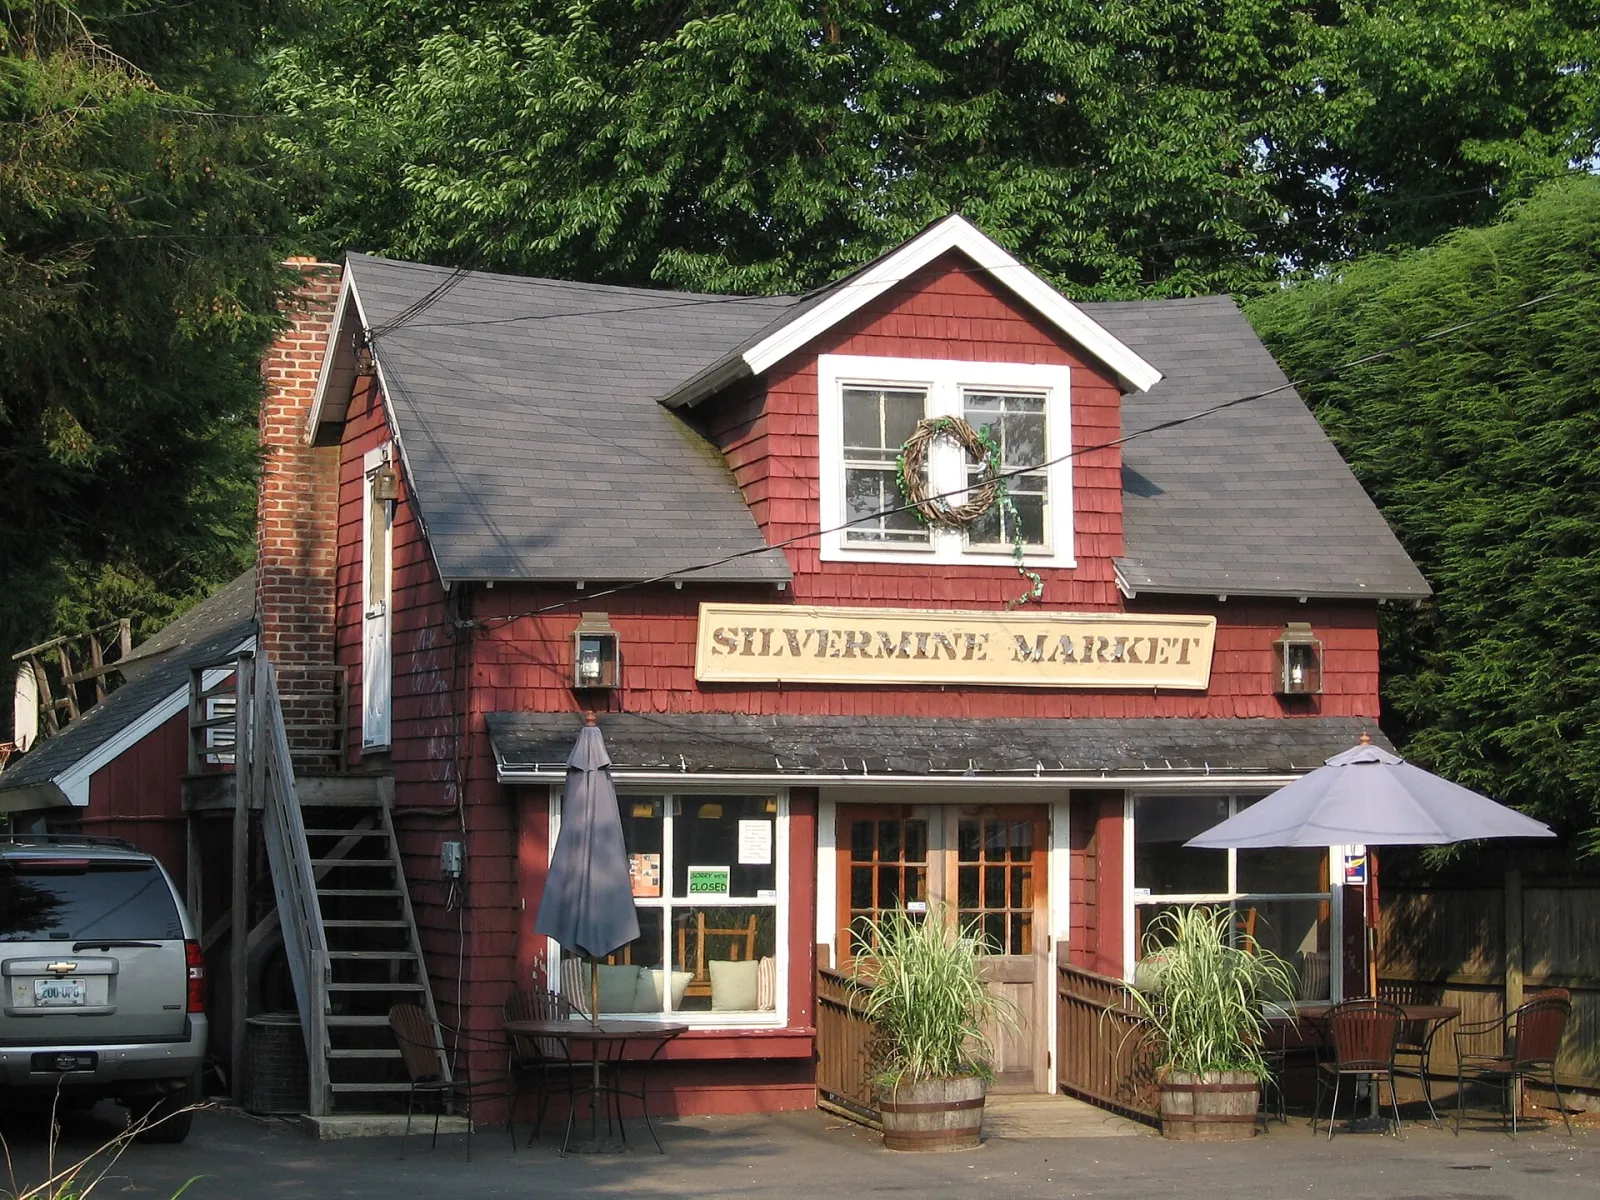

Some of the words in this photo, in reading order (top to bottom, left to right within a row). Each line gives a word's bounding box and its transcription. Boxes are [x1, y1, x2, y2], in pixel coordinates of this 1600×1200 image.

[711, 627, 990, 661] SILVERMINE
[1007, 634, 1201, 665] MARKET
[690, 882, 727, 891] CLOSED
